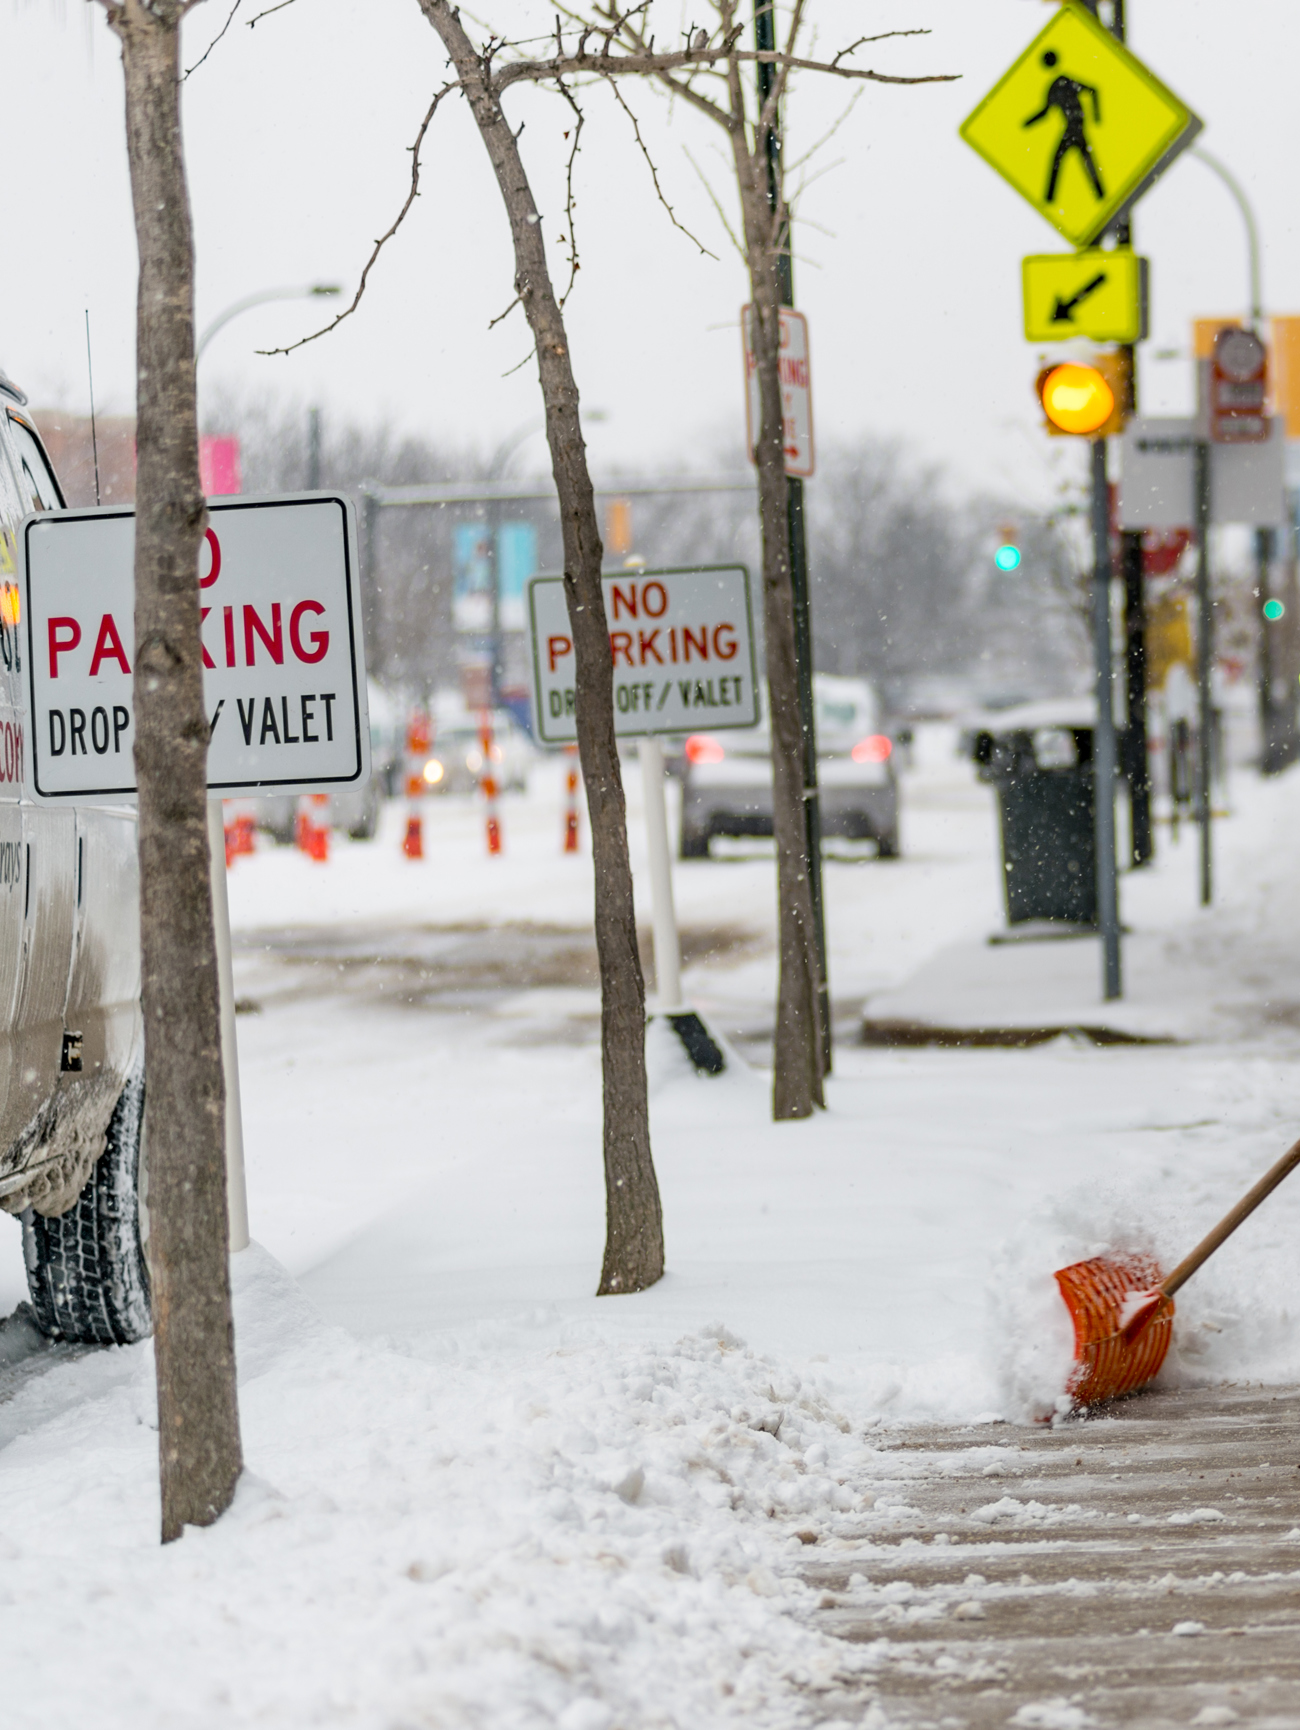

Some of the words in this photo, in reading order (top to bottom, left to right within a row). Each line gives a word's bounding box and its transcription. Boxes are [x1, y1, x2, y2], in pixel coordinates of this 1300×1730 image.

[611, 581, 669, 621] NO
[47, 599, 330, 680] PAING
[547, 622, 739, 674] PRKING
[678, 675, 743, 710] VALET
[48, 705, 131, 758] DROP
[236, 692, 337, 747] VALET
